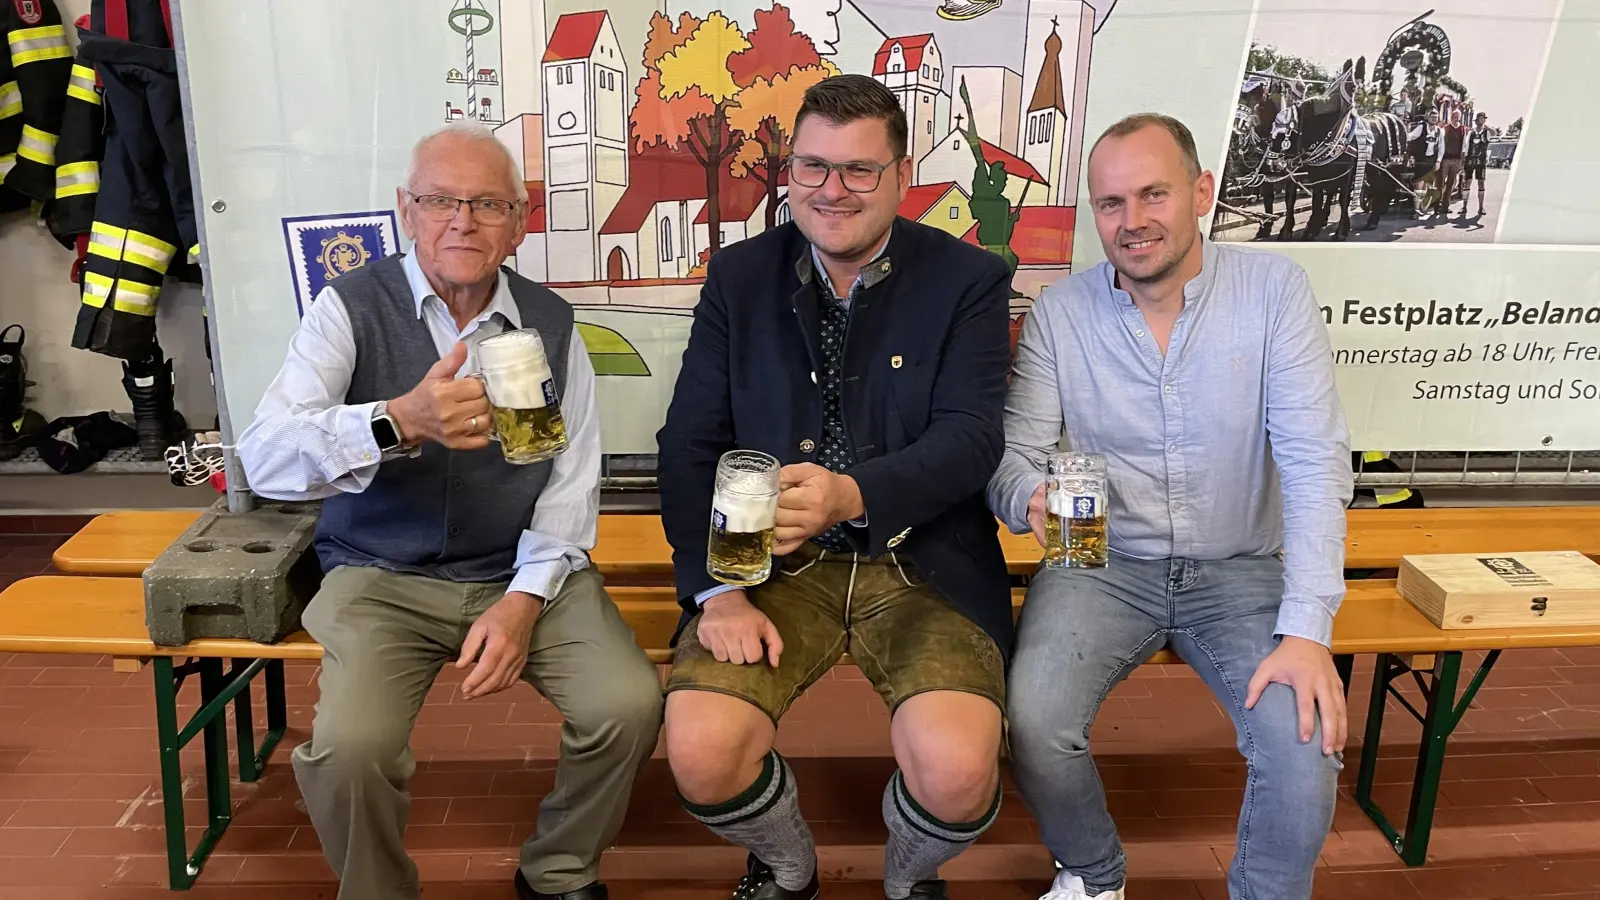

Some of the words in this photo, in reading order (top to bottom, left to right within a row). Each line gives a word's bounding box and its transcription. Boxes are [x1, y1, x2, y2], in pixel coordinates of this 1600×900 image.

[1342, 299, 1483, 332] Festplatz
[1332, 346, 1438, 368] nnerstag
[1443, 343, 1472, 362] ab
[1482, 343, 1507, 361] 18
[1513, 341, 1555, 364] Uhr,
[1412, 380, 1511, 405] Samstag
[1518, 378, 1563, 399] und
[1569, 379, 1600, 399] So
